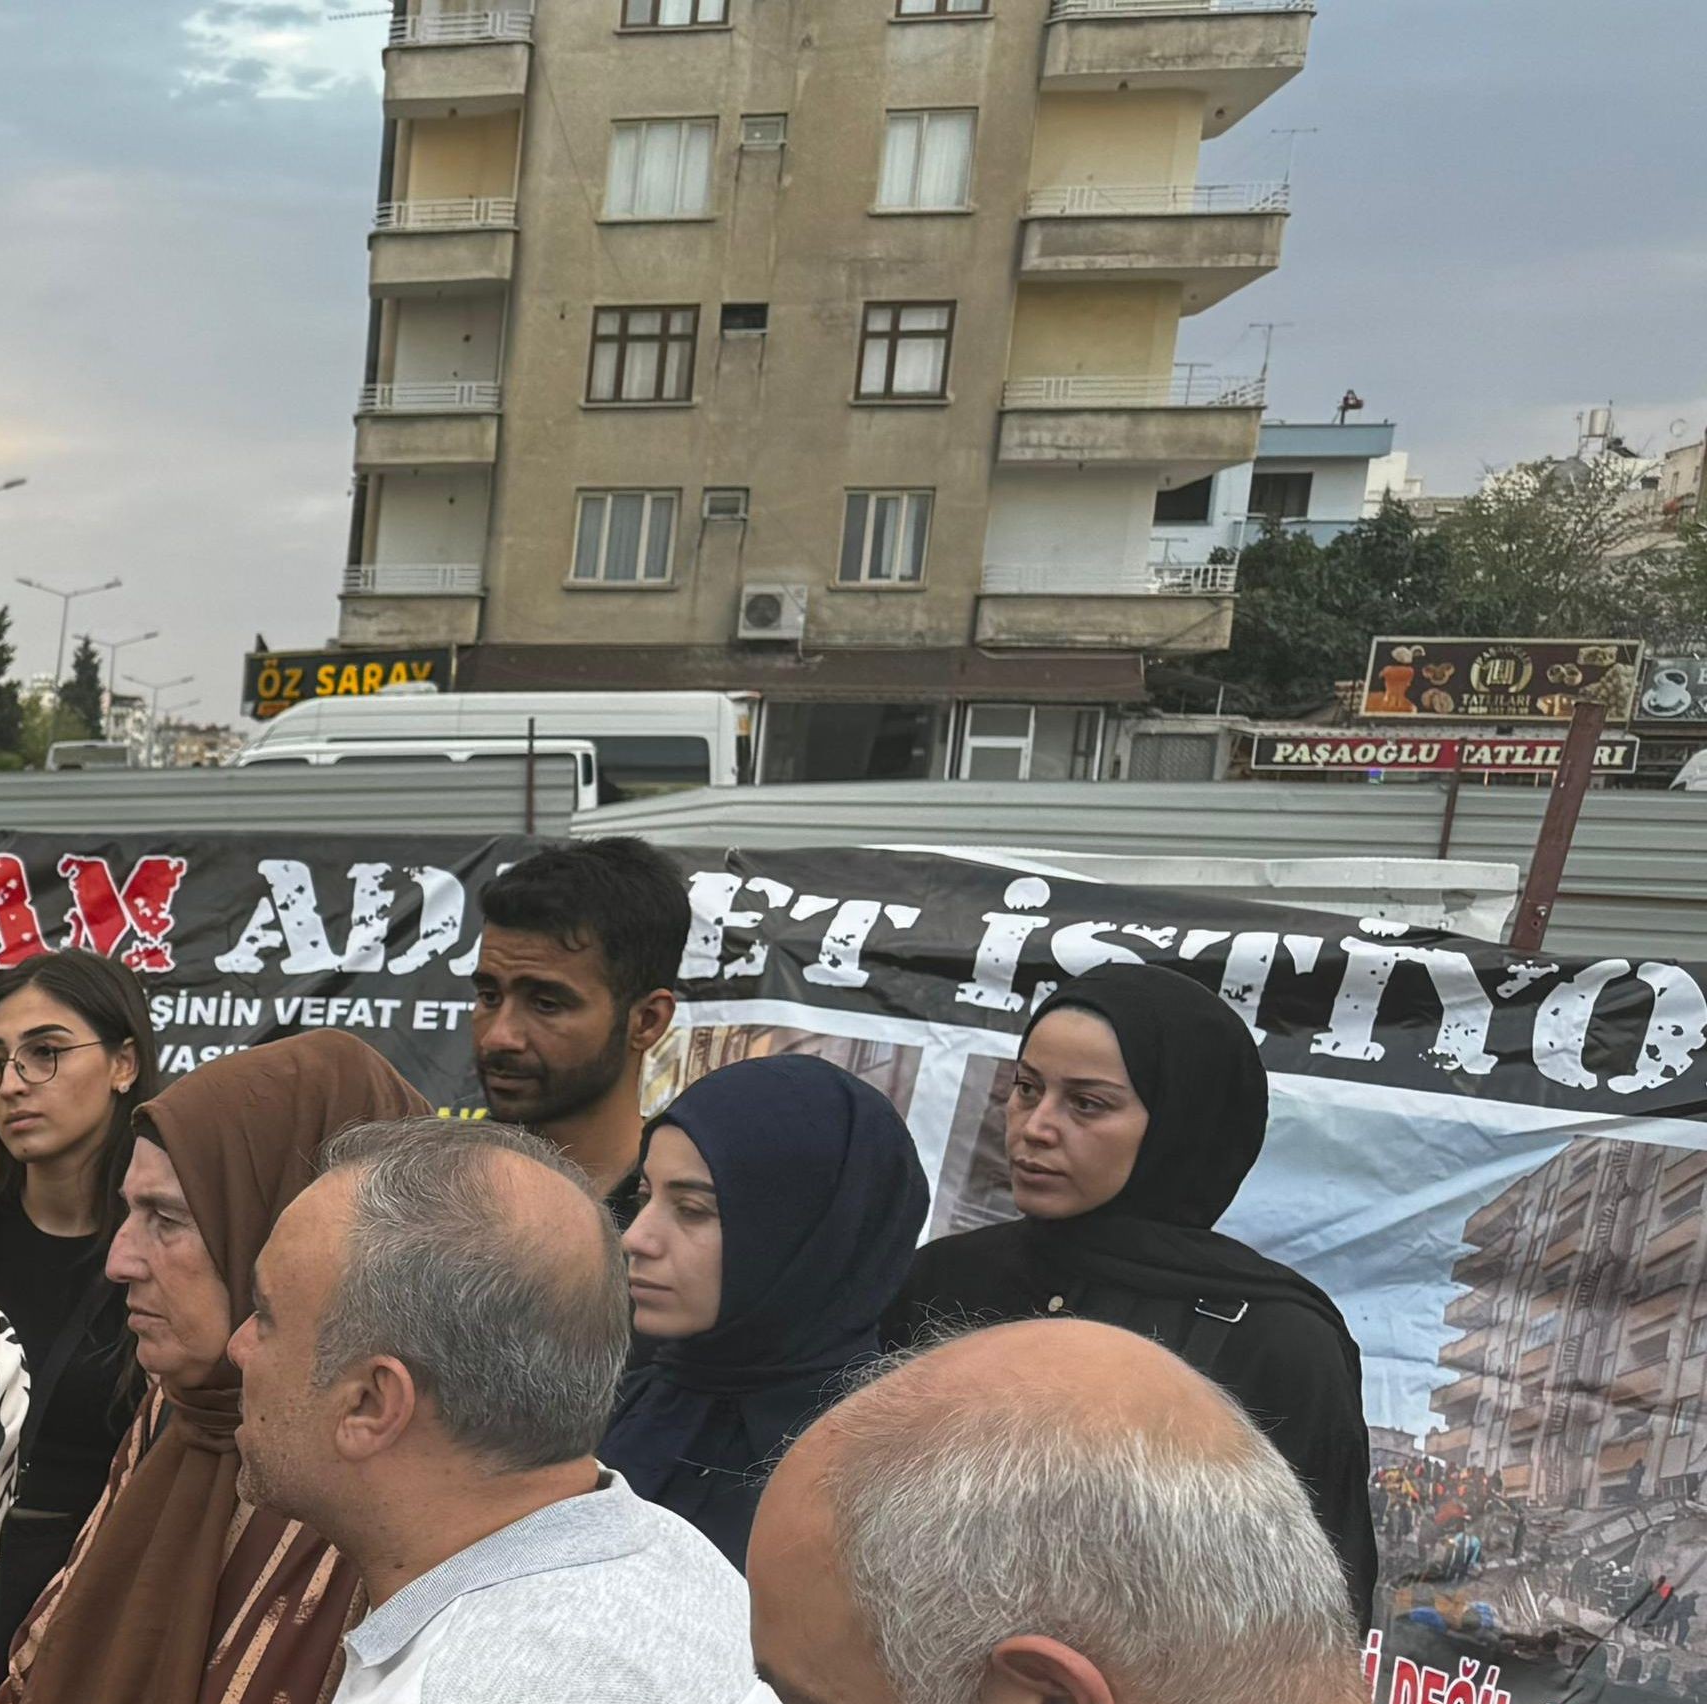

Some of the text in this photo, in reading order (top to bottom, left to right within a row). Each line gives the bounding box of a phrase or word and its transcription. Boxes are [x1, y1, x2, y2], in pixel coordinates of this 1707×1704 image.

[257, 657, 304, 699] ÖZ
[1272, 740, 1441, 769] PAŞAOĞLU
[143, 987, 263, 1032] ŞİNİN
[274, 997, 401, 1029] VEFAT
